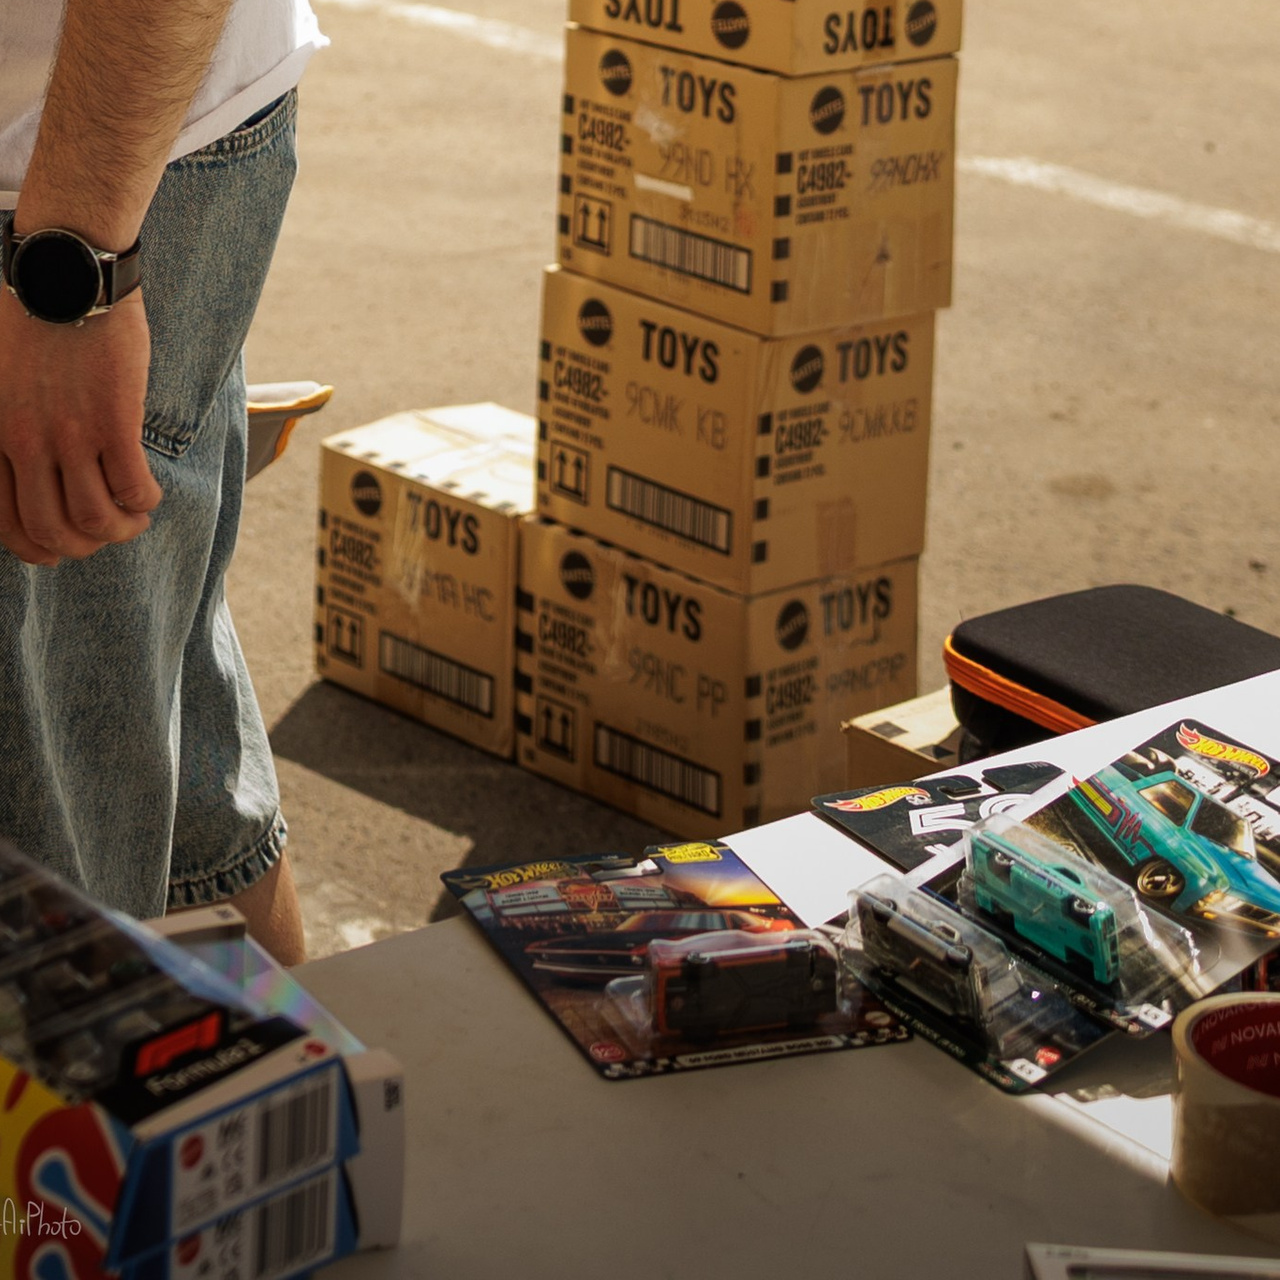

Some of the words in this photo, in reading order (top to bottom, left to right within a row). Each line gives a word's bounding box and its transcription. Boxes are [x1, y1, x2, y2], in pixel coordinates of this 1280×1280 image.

[823, 5, 896, 55] TOYS
[660, 65, 736, 124] TOYS
[857, 77, 933, 126] TOYS
[578, 112, 632, 152] C4982-
[797, 160, 853, 194] C4982-
[640, 318, 719, 383] TOYS
[836, 330, 909, 383] TOYS
[554, 359, 609, 402] C4982-
[775, 418, 830, 454] C4982-
[407, 490, 480, 556] TOYS
[623, 572, 702, 643] TOYS
[821, 576, 892, 636] TOYS
[486, 869, 522, 889] HOT
